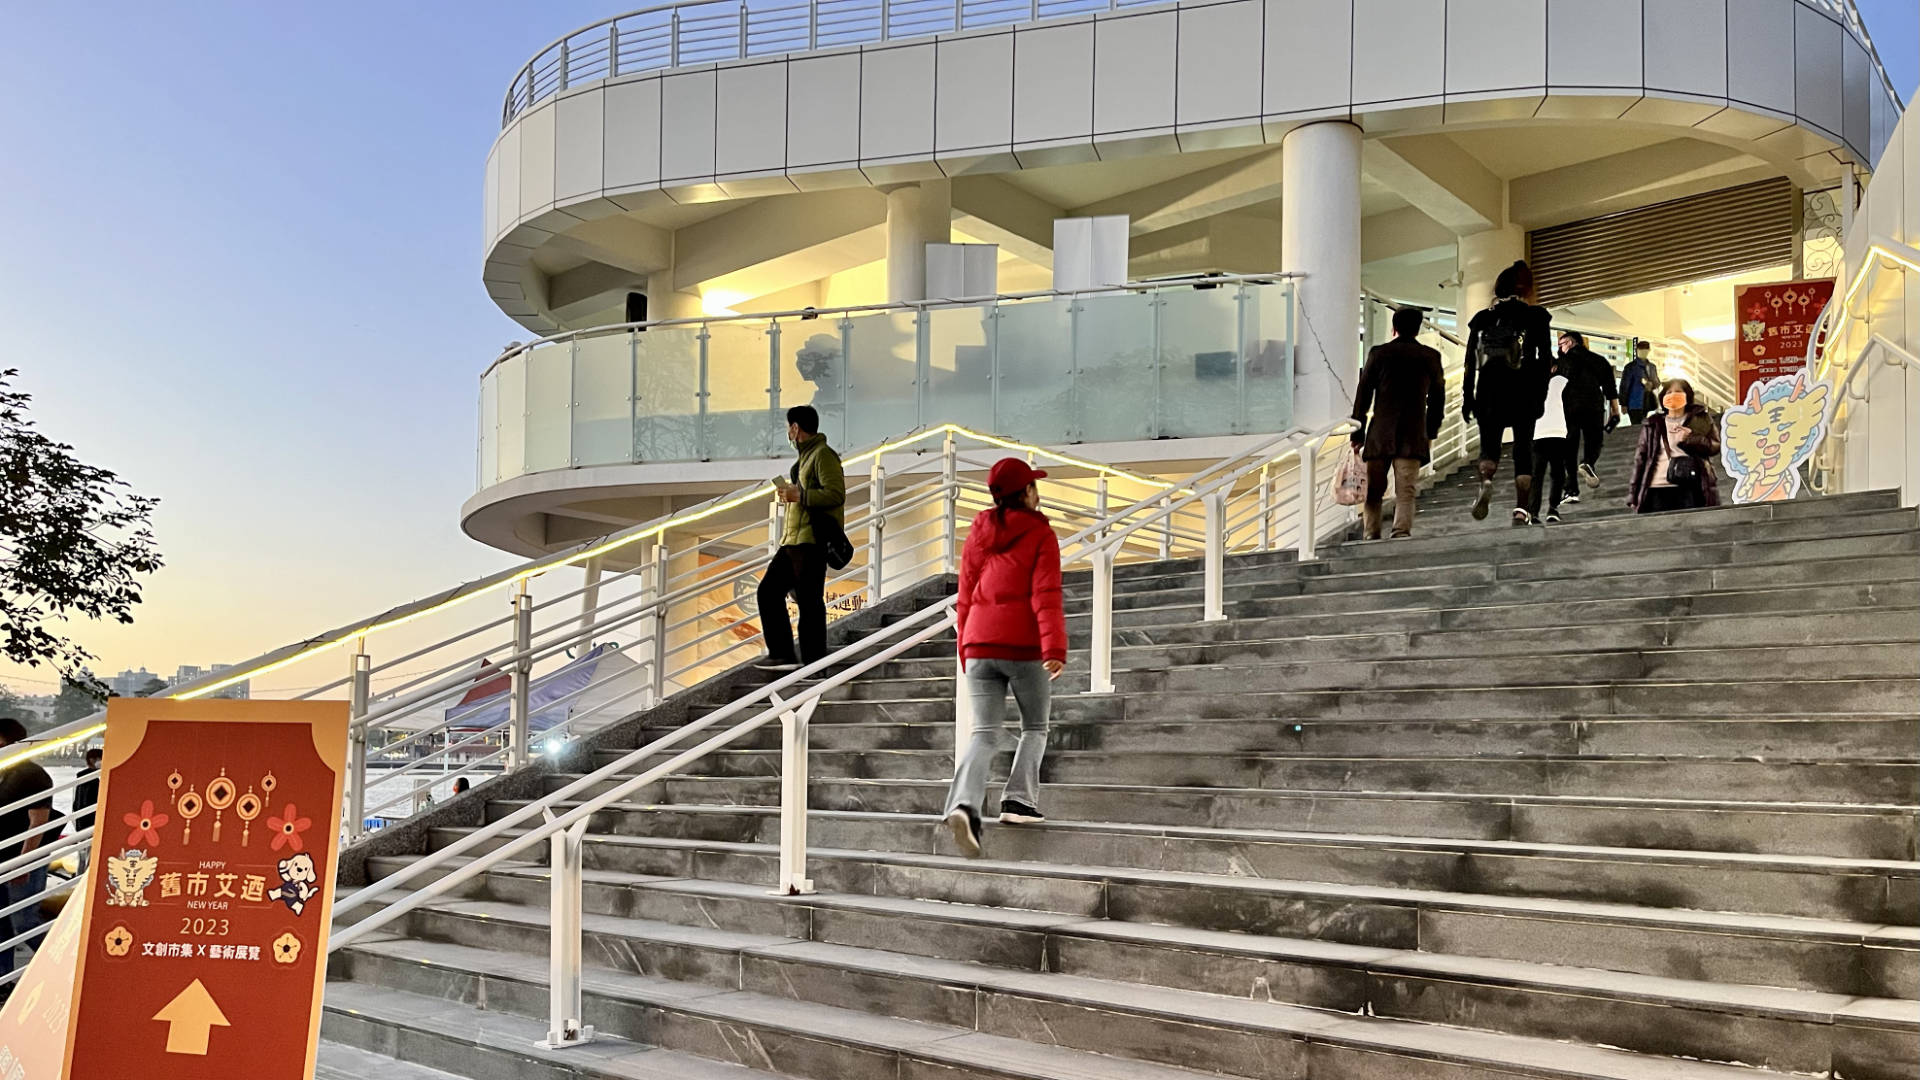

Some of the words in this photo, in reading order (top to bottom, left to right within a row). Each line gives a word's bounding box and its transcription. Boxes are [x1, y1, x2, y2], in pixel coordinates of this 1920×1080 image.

[199, 861, 227, 870] HAPPY
[187, 901, 206, 909] NEW
[208, 901, 229, 910] YEAR
[180, 917, 230, 936] 2023
[141, 942, 193, 957] 文創市集
[209, 944, 261, 960] 藝術展覽
